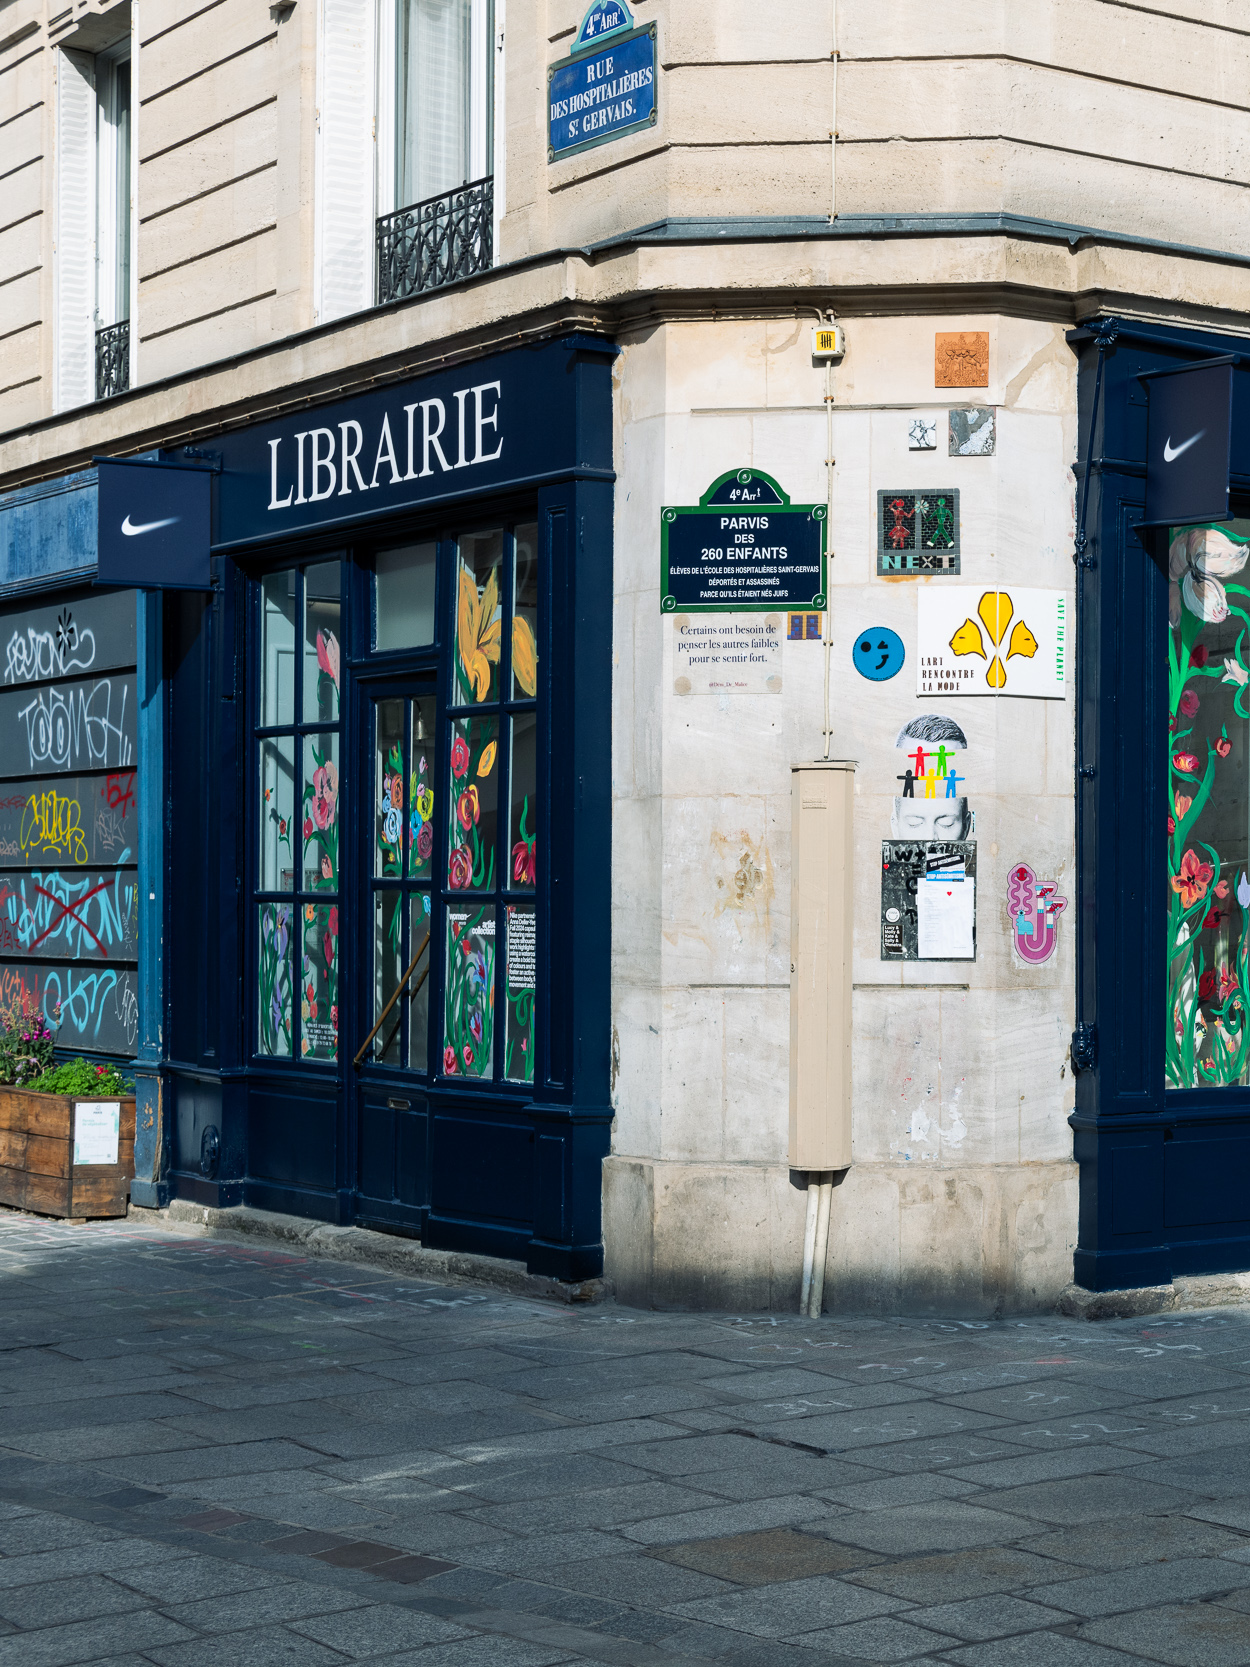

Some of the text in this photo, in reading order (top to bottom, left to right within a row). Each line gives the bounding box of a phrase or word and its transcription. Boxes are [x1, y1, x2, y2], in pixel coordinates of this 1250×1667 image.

[586, 56, 614, 84] RUE
[550, 66, 653, 122] DES HOSPITALIÈRES
[267, 380, 504, 511] LIBRAIRIE
[730, 488, 741, 500] 4e
[720, 516, 769, 530] PARVIS
[734, 534, 754, 544] DES
[701, 546, 788, 560] 260 ENFANTS
[882, 554, 956, 569] NEXT
[670, 566, 690, 574] ÉLÈVES
[700, 566, 723, 574] L'ÉCOLE
[736, 565, 778, 574] HOSPITALIÈRES
[708, 577, 737, 586] DÉPORTÉS
[746, 576, 780, 585] ASSASSINÉS
[738, 589, 761, 597] ÉTAIENT
[761, 589, 772, 597] NÉS
[680, 625, 717, 636] Certains
[735, 624, 764, 634] besoin
[765, 624, 776, 634] de
[678, 638, 779, 652] penser les autres faibles
[1056, 598, 1065, 682] SAVE THE PLANET
[689, 655, 709, 666] pour
[722, 653, 748, 662] sentir
[749, 652, 768, 662] fort.
[922, 669, 975, 679] RENCONTRE
[922, 682, 960, 692] LA MODE
[472, 926, 495, 935] collection
